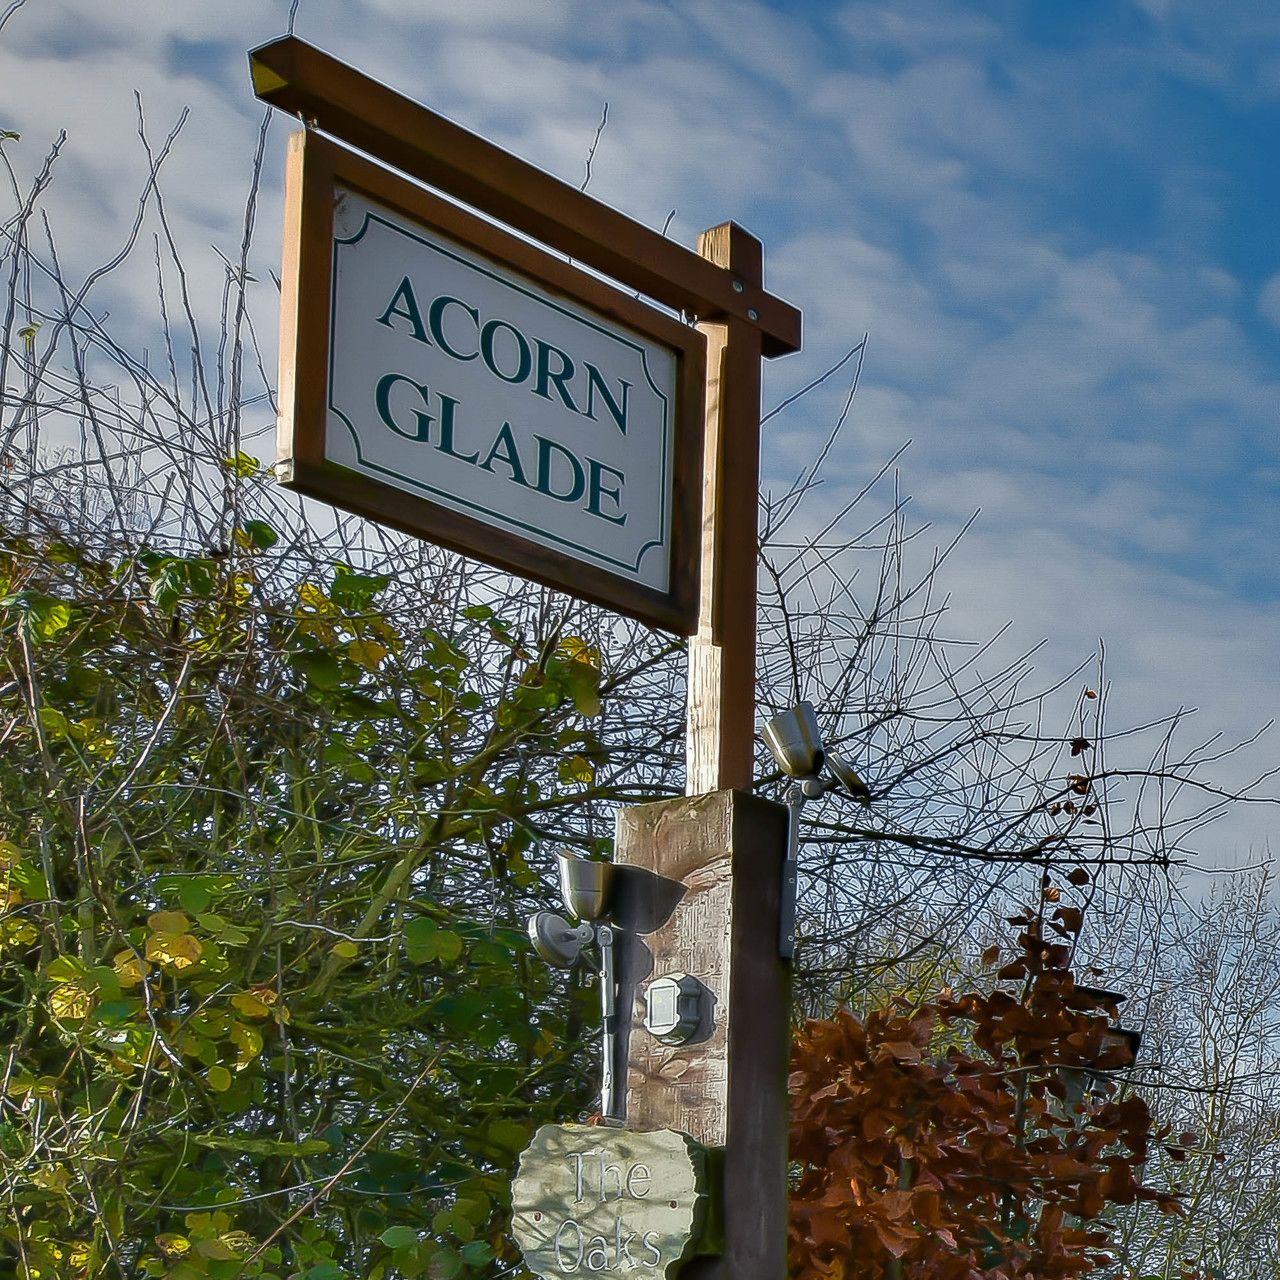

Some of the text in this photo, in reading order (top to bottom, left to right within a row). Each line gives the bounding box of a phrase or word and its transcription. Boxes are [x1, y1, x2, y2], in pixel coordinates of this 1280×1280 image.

[375, 275, 632, 436] ACORN
[375, 373, 628, 526] GLADE
[566, 1149, 651, 1204] The
[554, 1216, 662, 1273] Oaks
